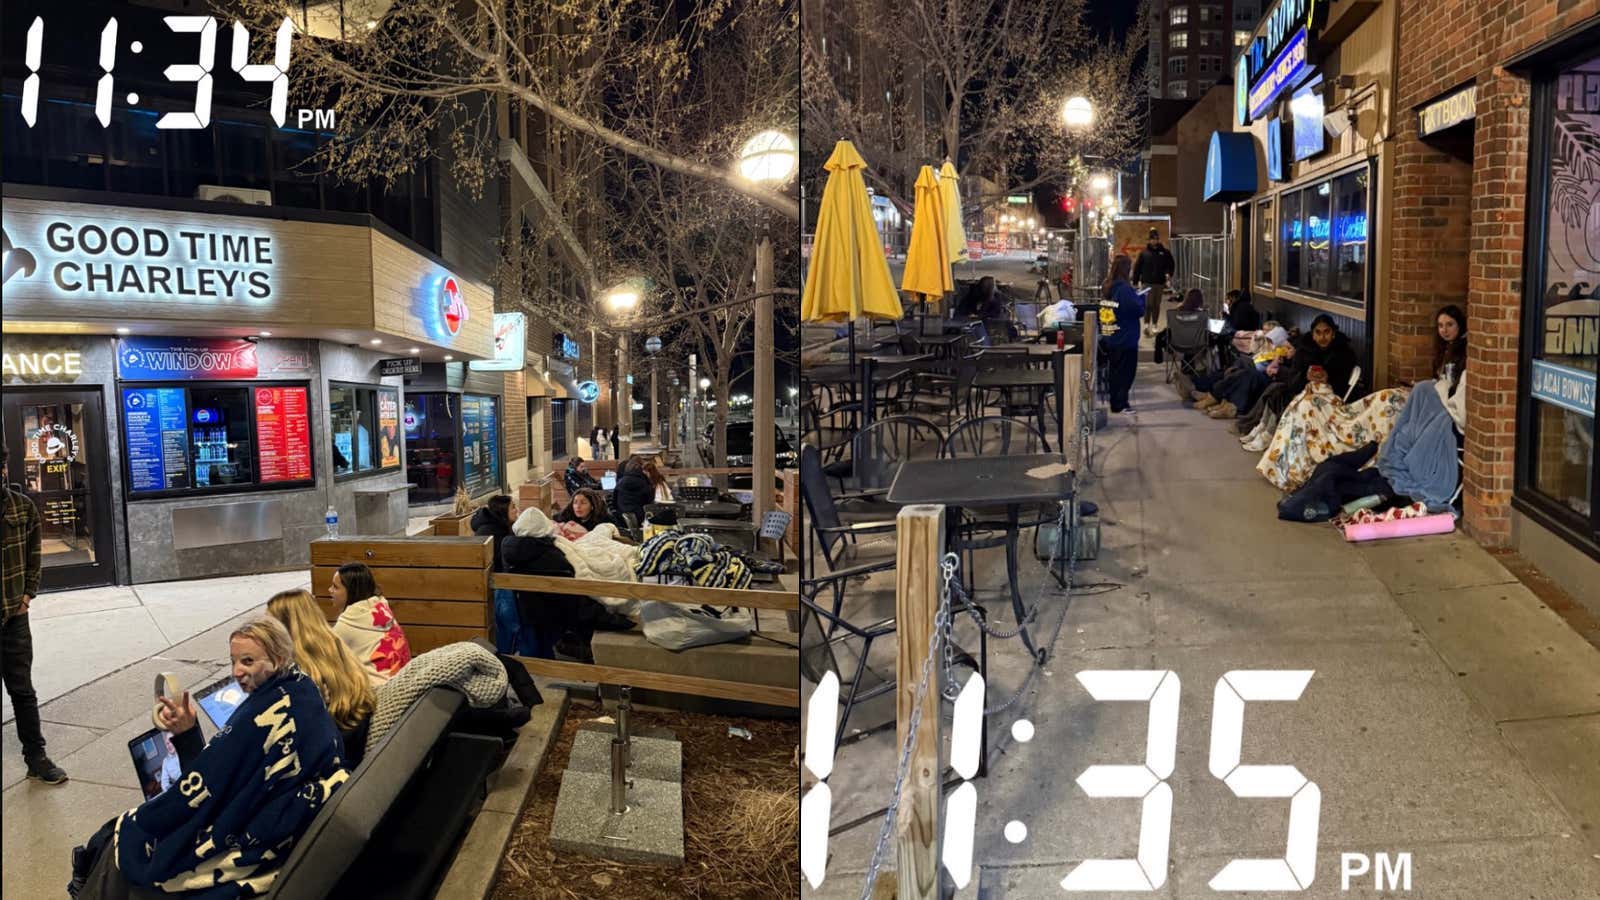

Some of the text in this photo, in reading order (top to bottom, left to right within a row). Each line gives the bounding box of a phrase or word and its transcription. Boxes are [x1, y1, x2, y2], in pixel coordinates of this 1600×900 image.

[46, 222, 273, 264] GOOD TIME
[53, 261, 272, 299] CHARLEY'S
[3, 352, 82, 375] ANCE
[146, 352, 232, 371] WINDOW
[47, 464, 68, 473] EXIT
